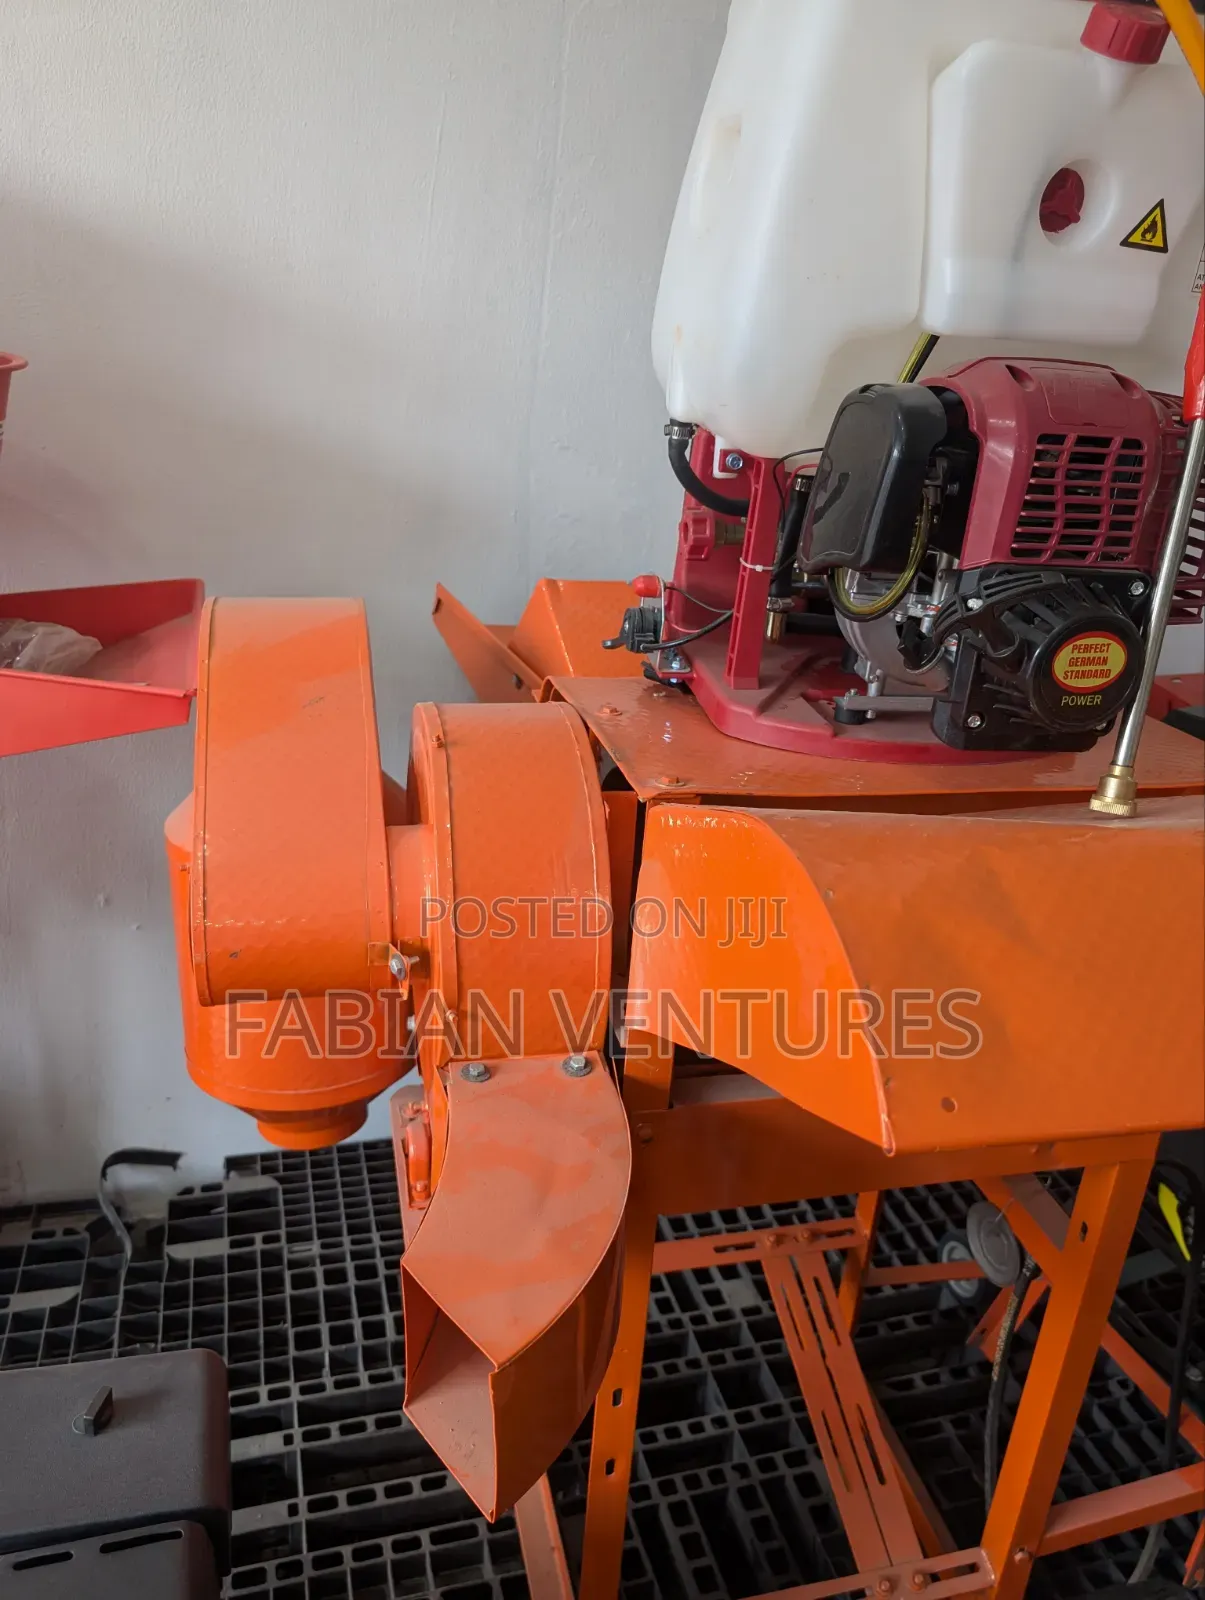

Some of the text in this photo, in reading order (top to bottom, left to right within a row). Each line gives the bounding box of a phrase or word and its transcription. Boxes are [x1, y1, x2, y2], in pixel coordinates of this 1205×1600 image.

[1071, 643, 1111, 654] PERFECT
[1068, 656, 1108, 667] GERMAN
[1063, 669, 1111, 680] STANDARD
[1061, 695, 1102, 706] POWER
